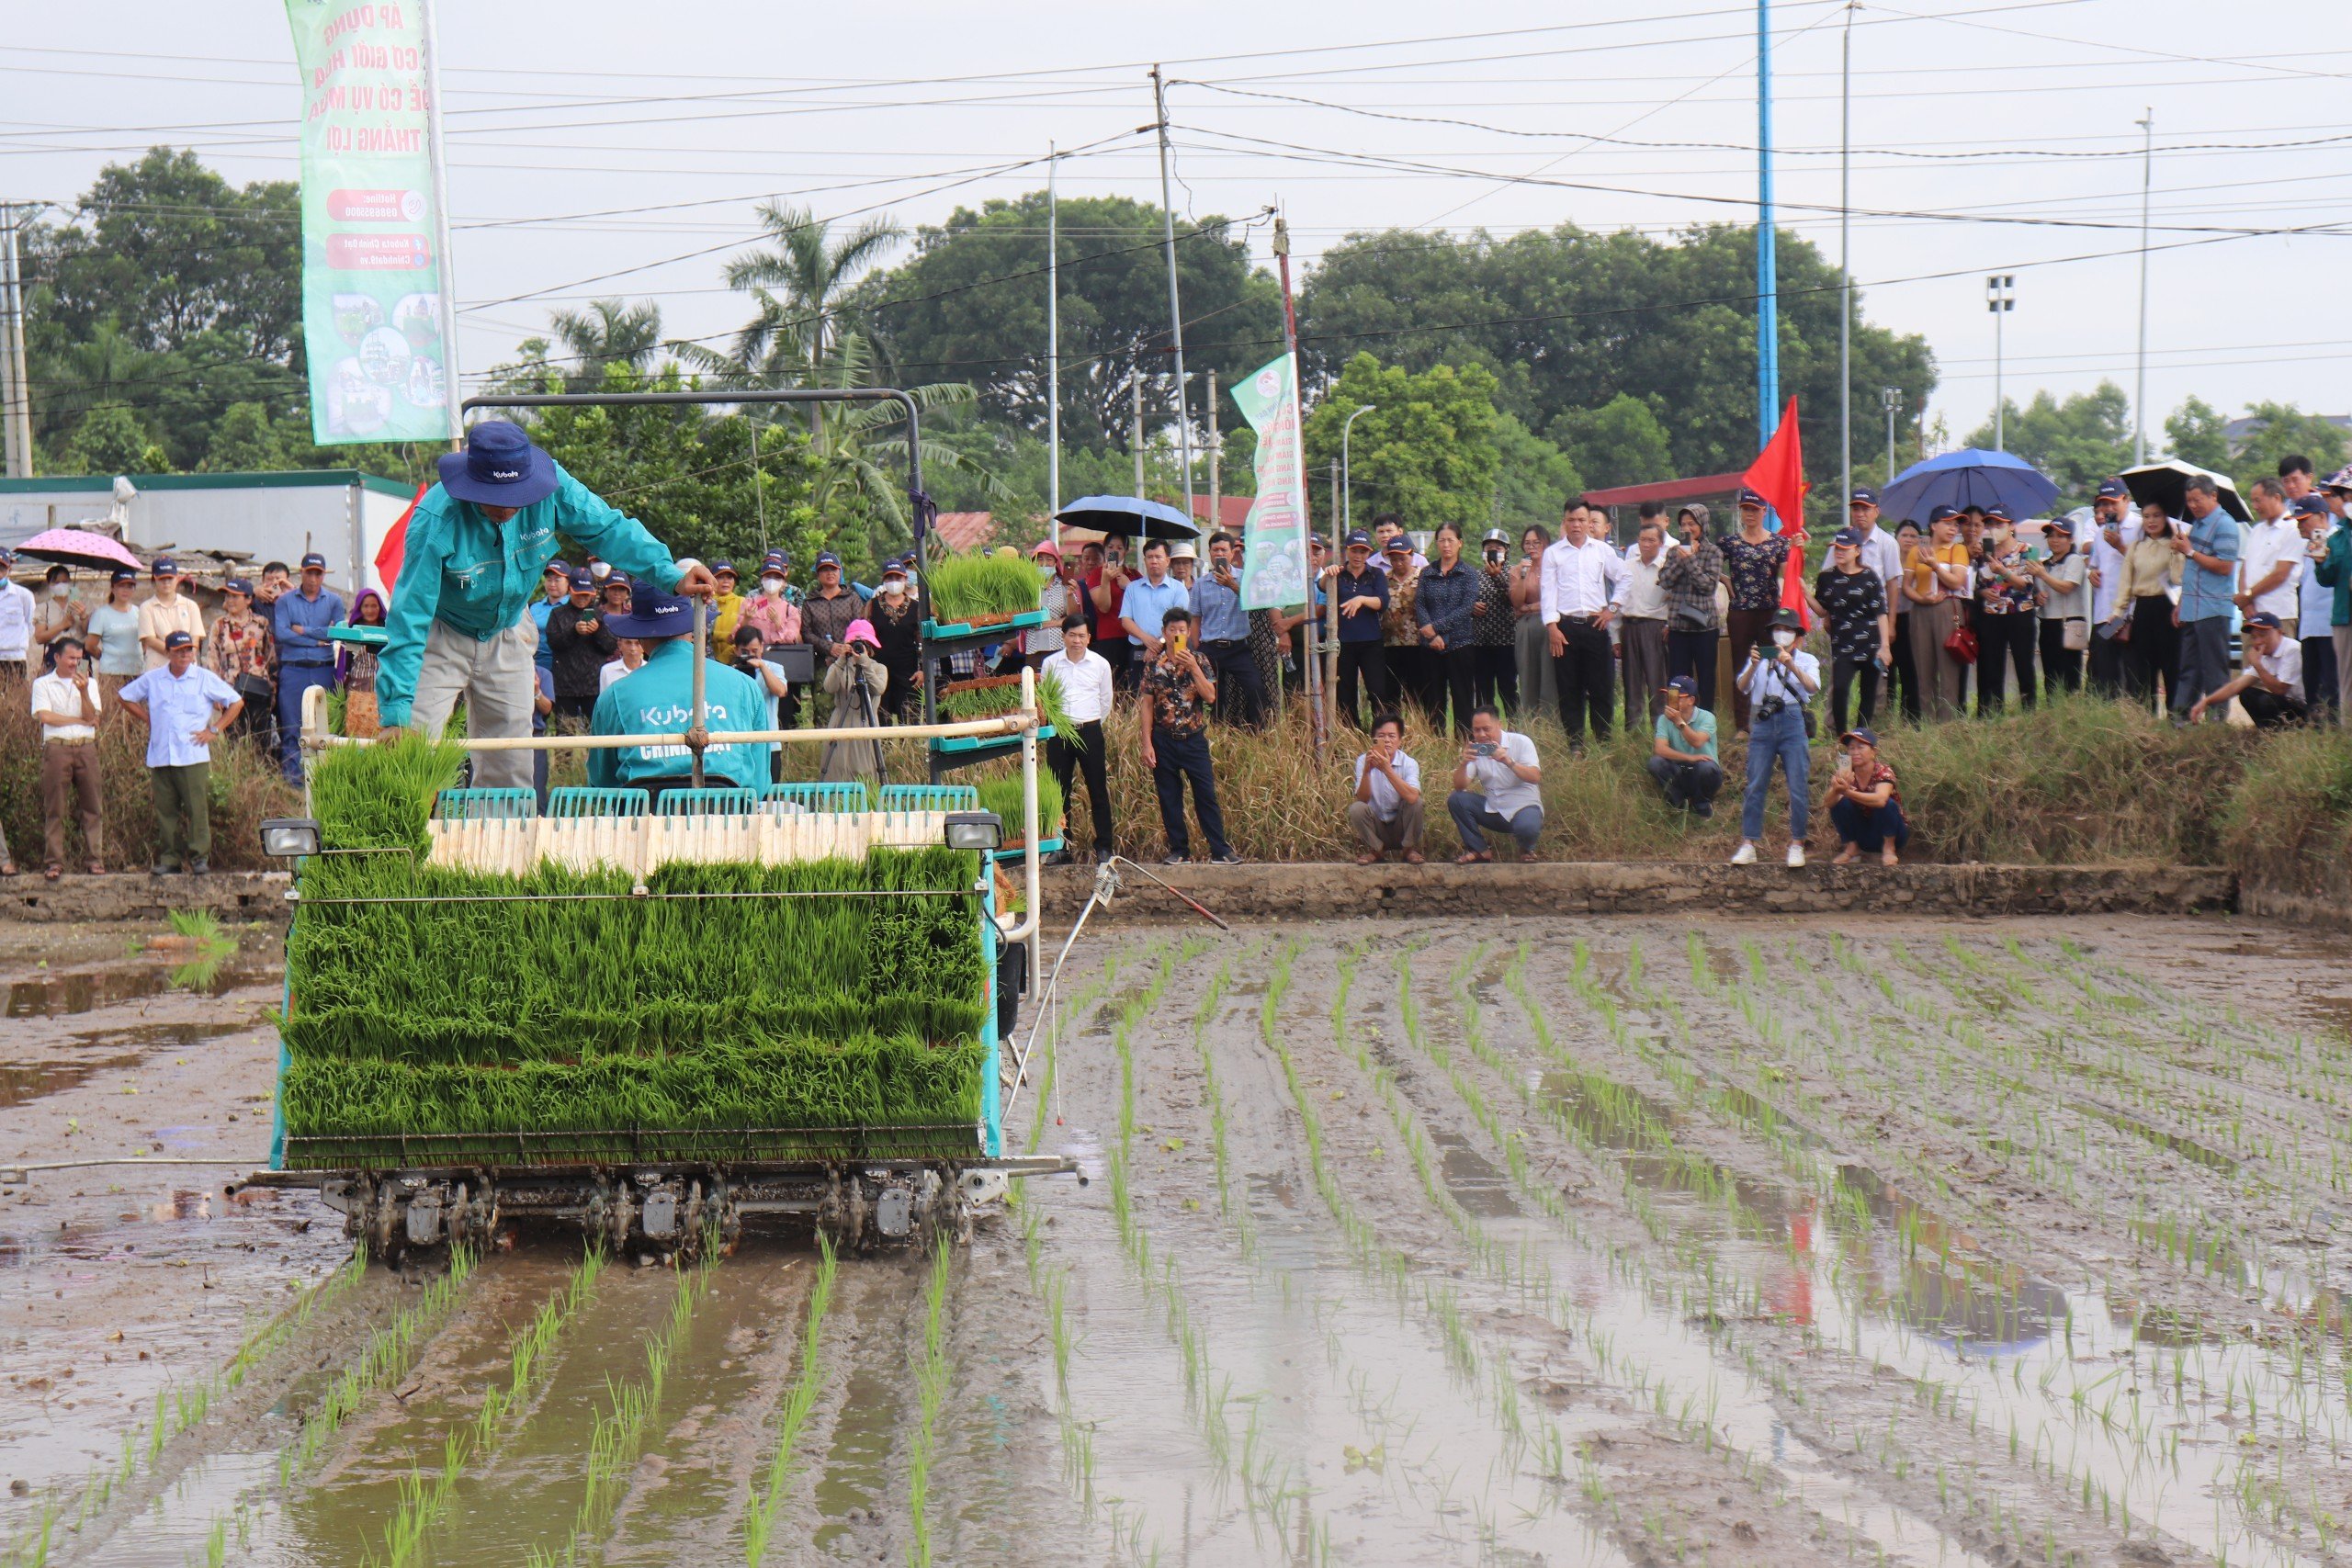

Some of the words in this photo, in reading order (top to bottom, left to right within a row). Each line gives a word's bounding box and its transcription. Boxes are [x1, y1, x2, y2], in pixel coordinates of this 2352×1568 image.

[492, 469, 519, 479] Kubota
[519, 526, 549, 541] Kubota
[654, 605, 679, 615] Kubota
[639, 701, 727, 726] Kubta
